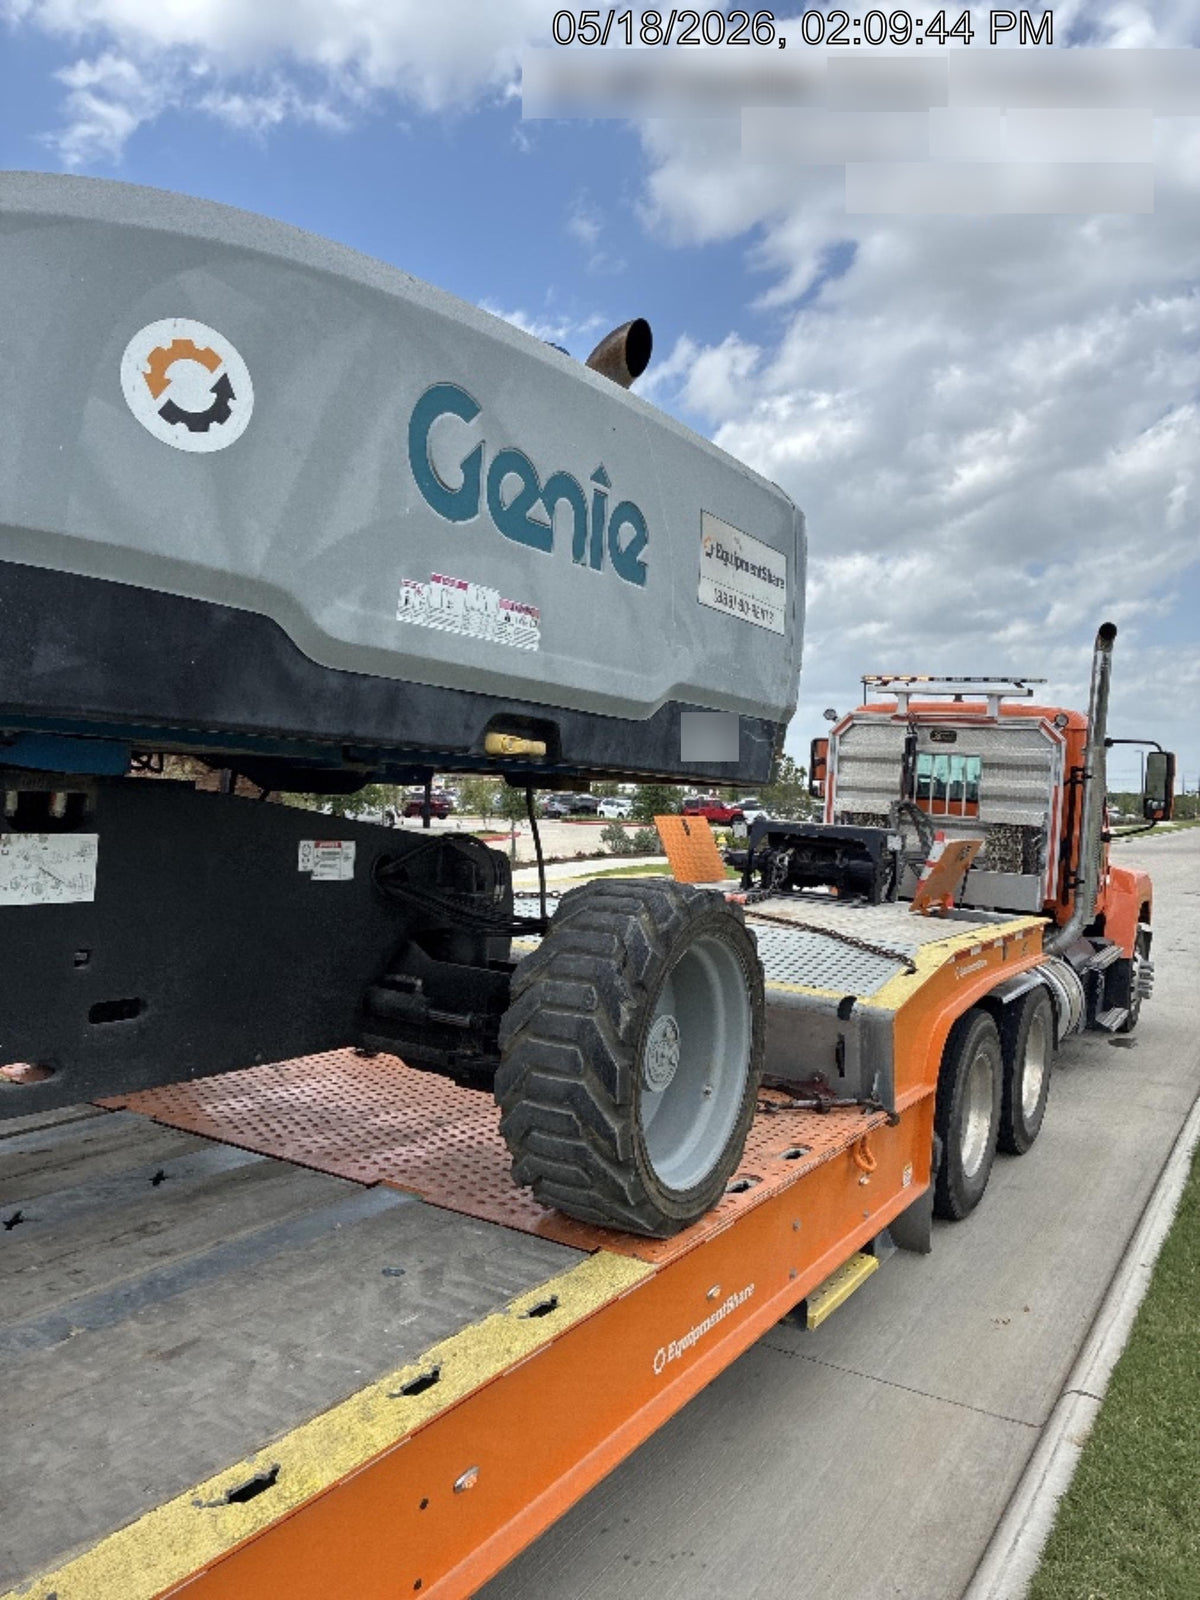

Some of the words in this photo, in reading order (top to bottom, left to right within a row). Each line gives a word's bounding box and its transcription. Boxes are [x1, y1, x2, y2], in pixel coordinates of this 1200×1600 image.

[408, 382, 649, 587] Genie
[716, 541, 785, 589] EquipmentShare
[667, 1283, 756, 1363] EquipmentShare
